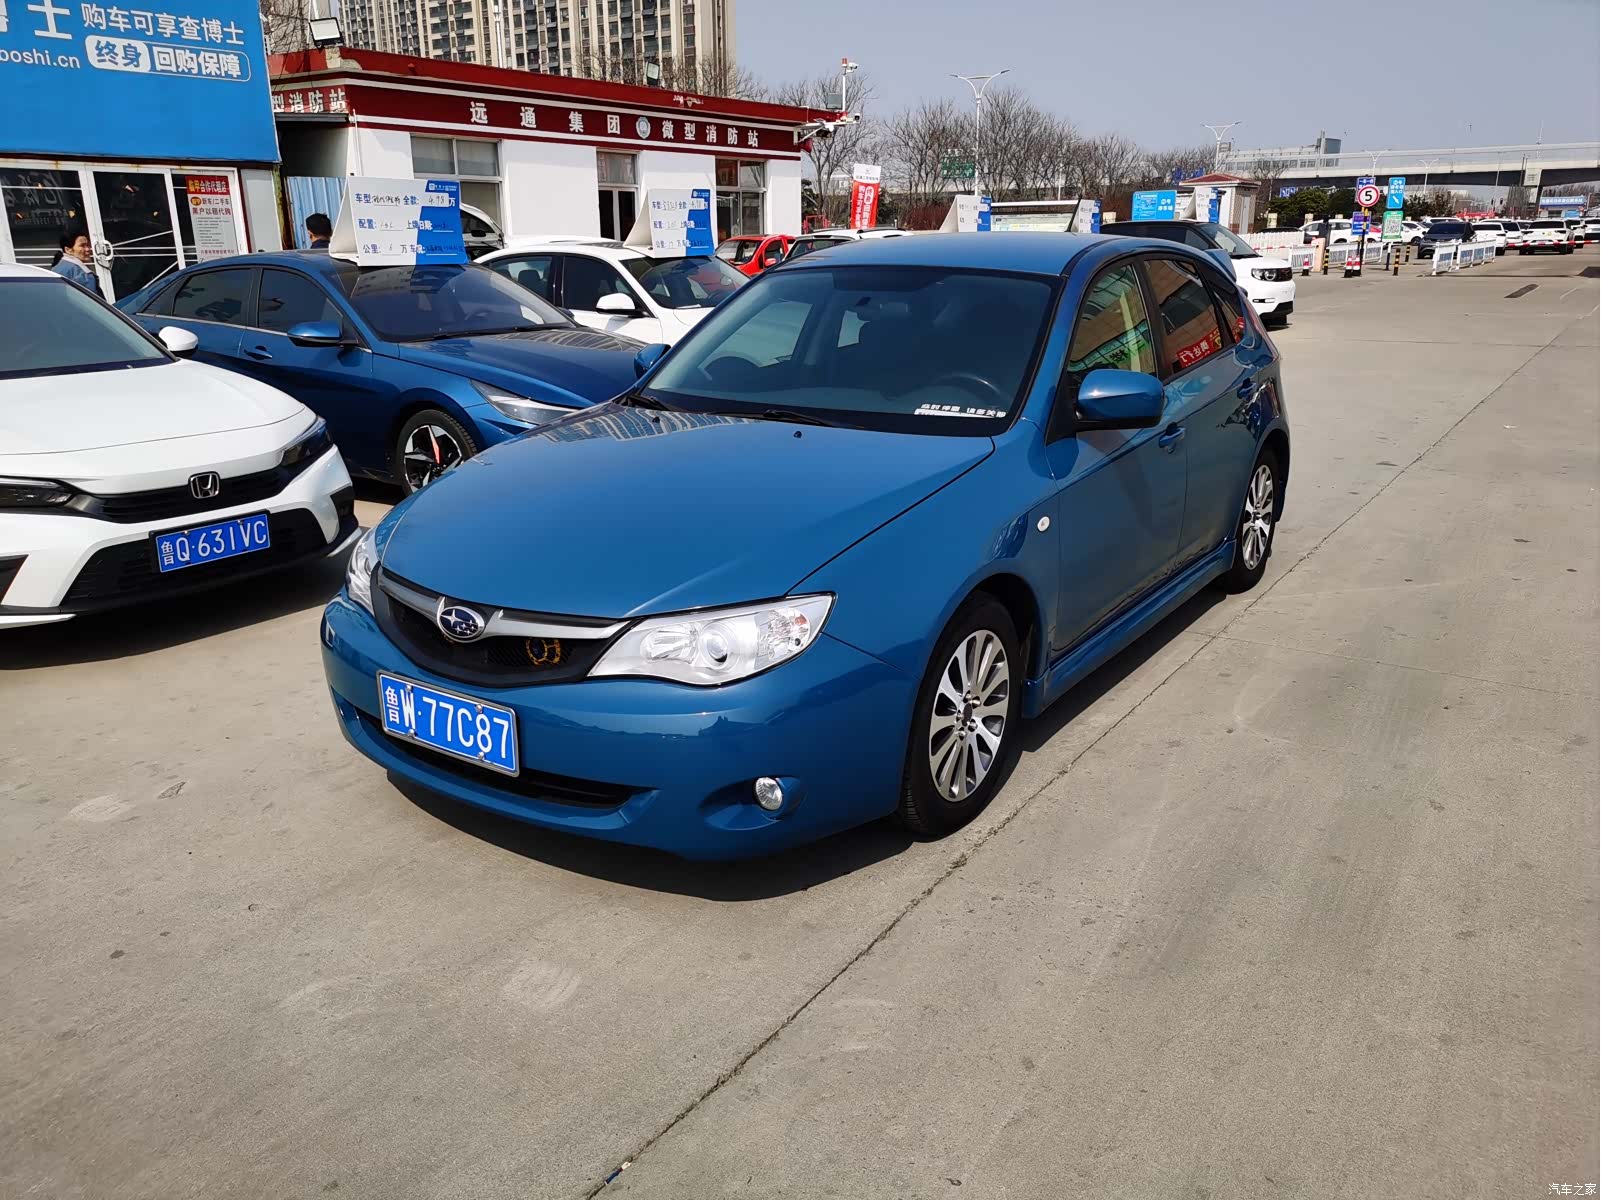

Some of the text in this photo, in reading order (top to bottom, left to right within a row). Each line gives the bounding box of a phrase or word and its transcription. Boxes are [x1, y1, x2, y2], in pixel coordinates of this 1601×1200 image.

[0, 0, 72, 39] 士
[80, 3, 244, 45] 购车可享查博士
[95, 39, 241, 78] 终身 回购保障
[470, 101, 759, 148] 远通集团 微型消防站
[1365, 190, 1373, 201] 5
